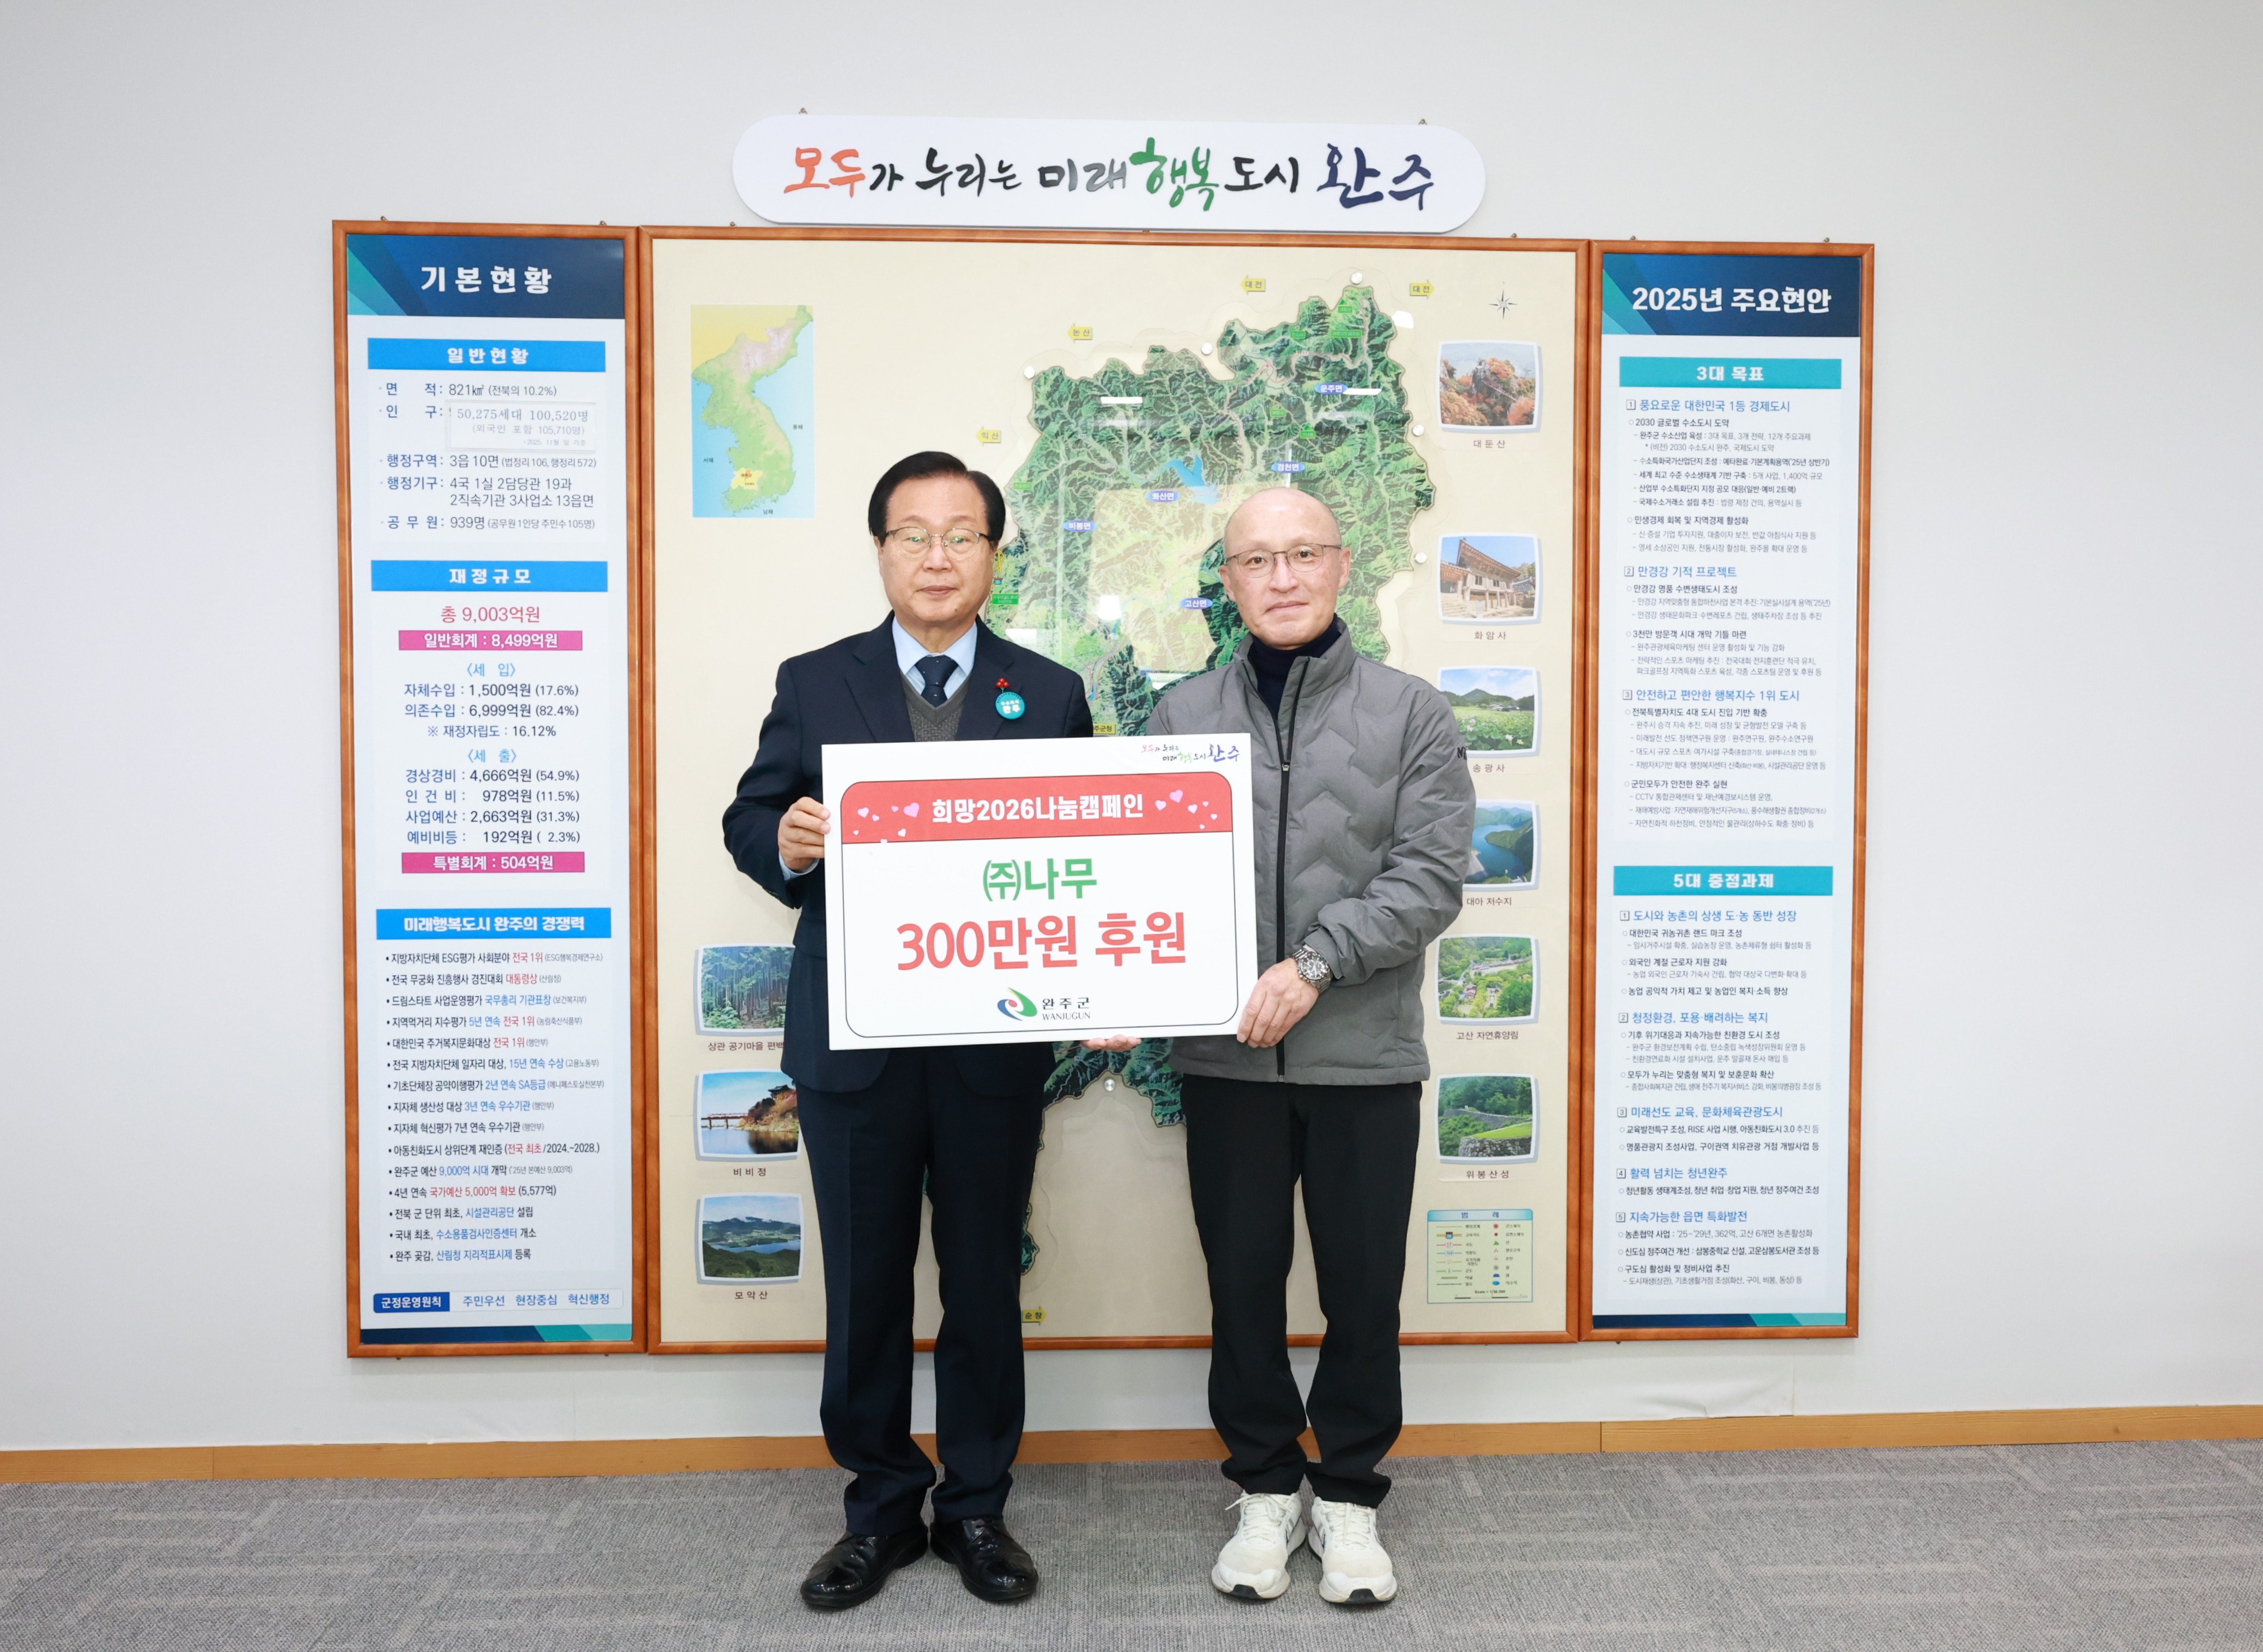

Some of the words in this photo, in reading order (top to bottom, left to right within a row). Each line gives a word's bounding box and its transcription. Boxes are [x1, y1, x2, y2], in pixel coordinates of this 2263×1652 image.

[784, 146, 904, 195] 모두가
[916, 147, 1022, 198] 누리는
[1632, 287, 1723, 312] 2025년
[1731, 286, 1832, 314] 주요현안
[1697, 366, 1724, 381] 3대
[1732, 366, 1764, 381] 목표
[488, 385, 520, 396] (전북의
[524, 386, 557, 396] 10.2%)
[1320, 384, 1343, 393] 운주면
[1640, 399, 1681, 411] 풍요로운
[1685, 400, 1725, 412] 대한민국
[1730, 400, 1745, 412] 1등
[1749, 401, 1790, 412] 경제도시
[457, 408, 522, 421] 50,275세대
[530, 410, 588, 423] 100,520명
[1657, 418, 1679, 427] 글로벌
[1682, 419, 1712, 428] 수소도시
[1714, 419, 1729, 428] 도약
[450, 454, 470, 468] 3읍
[473, 455, 499, 468] 10면
[501, 458, 530, 468] (법정리
[551, 458, 576, 467] 행정리
[577, 459, 597, 468] 572)
[1277, 463, 1299, 472] 경천면
[450, 477, 469, 490] 4국
[475, 477, 492, 491] 1실
[497, 477, 541, 491] 2담당관
[546, 478, 572, 491] 19과
[450, 494, 506, 507] 2직속기관
[509, 494, 553, 507] 3사업소
[557, 494, 593, 508] 13읍면
[1151, 492, 1174, 501] 화산면
[1068, 522, 1091, 530] 비봉면
[1638, 566, 1669, 578] 만경강
[1673, 566, 1692, 578] 기적
[1696, 566, 1737, 578] 프로젝트
[1184, 599, 1207, 608] 고산면
[441, 606, 457, 624] 총
[462, 606, 540, 623] 9,003억원
[1633, 629, 1653, 639] 3천만
[1655, 630, 1677, 639] 방문객
[1680, 630, 1695, 639] 시대
[1697, 630, 1712, 639] 개막
[1732, 630, 1746, 639] 마련
[424, 633, 477, 648] 일반회계
[492, 633, 558, 649] 8,499억원
[404, 683, 455, 697] 자체수입
[469, 683, 531, 697] 1,500억원
[535, 685, 579, 697] (17.6%)
[1636, 690, 1677, 701] 안전하고
[1681, 690, 1711, 701] 편안한
[1715, 690, 1755, 701] 행복지수
[1760, 690, 1775, 701] 1위
[1779, 690, 1799, 701] 도시
[405, 704, 455, 718] 의존수입
[469, 703, 531, 718] 6,999억원
[535, 705, 579, 717] (82.4%)
[443, 725, 500, 738] 재정자립도
[513, 725, 557, 737] 16.12%
[1093, 725, 1113, 733] 주군청
[1142, 744, 1161, 753] 모두가
[1162, 743, 1179, 752] 누리는
[932, 793, 1144, 824] 희망2026나눔캠페인
[406, 810, 458, 824] 사업예산
[470, 810, 532, 824] 2,663억원
[536, 811, 580, 823] (31.3%)
[433, 856, 487, 871] 특별회계
[501, 855, 553, 870] 504억원
[1673, 873, 1701, 888] 5대
[1708, 873, 1774, 889] 중점과제
[1466, 897, 1483, 906] 대아
[1486, 897, 1511, 906] 저수지
[404, 916, 491, 932] 미래행복도시
[494, 917, 538, 931] 완주의
[542, 916, 585, 931] 경쟁력
[897, 915, 1078, 971] 300만원
[1095, 911, 1186, 967] 후원
[391, 953, 439, 964] 지방자치단체
[442, 952, 476, 964] ESG평가
[478, 952, 511, 963] 사회분야
[513, 952, 528, 963] 전국
[530, 952, 543, 962] 1위
[1042, 997, 1089, 1010] 완주군
[1042, 1012, 1090, 1021] WANJUGUN
[1632, 1012, 1675, 1024] 청정환경,
[1748, 1012, 1768, 1024] 복지
[1456, 1031, 1474, 1040] 고산
[1476, 1031, 1518, 1040] 자연휴양림
[708, 1042, 725, 1051] 상관
[728, 1041, 763, 1051] 공기마을
[1631, 1107, 1671, 1118] 미래선도
[1674, 1106, 1698, 1118] 교육,
[1702, 1106, 1782, 1118] 문화체육관광도시
[394, 1166, 419, 1178] 완주군
[421, 1166, 437, 1177] 예산
[439, 1165, 470, 1176] 9,000억
[472, 1165, 489, 1176] 시대
[491, 1165, 507, 1176] 개막
[1630, 1168, 1649, 1179] 활력
[1654, 1168, 1684, 1179] 넘치는
[1687, 1167, 1727, 1179] 청년완주
[394, 1188, 408, 1199] 4년
[410, 1187, 427, 1198] 연속
[430, 1187, 462, 1198] 국가예산
[465, 1186, 497, 1197] 5,000억
[500, 1186, 516, 1196] 확보
[518, 1185, 557, 1197] (5,577억)
[1630, 1211, 1680, 1223] 지속가능한
[1683, 1211, 1703, 1222] 읍면
[1707, 1211, 1747, 1222] 특화발전
[395, 1229, 411, 1241] 국내
[414, 1229, 433, 1241] 최초,
[436, 1228, 517, 1240] 수소용품검사인증센터
[520, 1227, 536, 1238] 개소
[381, 1296, 442, 1309] 군정운영원칙
[463, 1295, 504, 1307] 주민우선
[516, 1294, 557, 1306] 현장중심
[568, 1293, 609, 1305] 혁신행정
[1025, 1311, 1042, 1320] 순창
